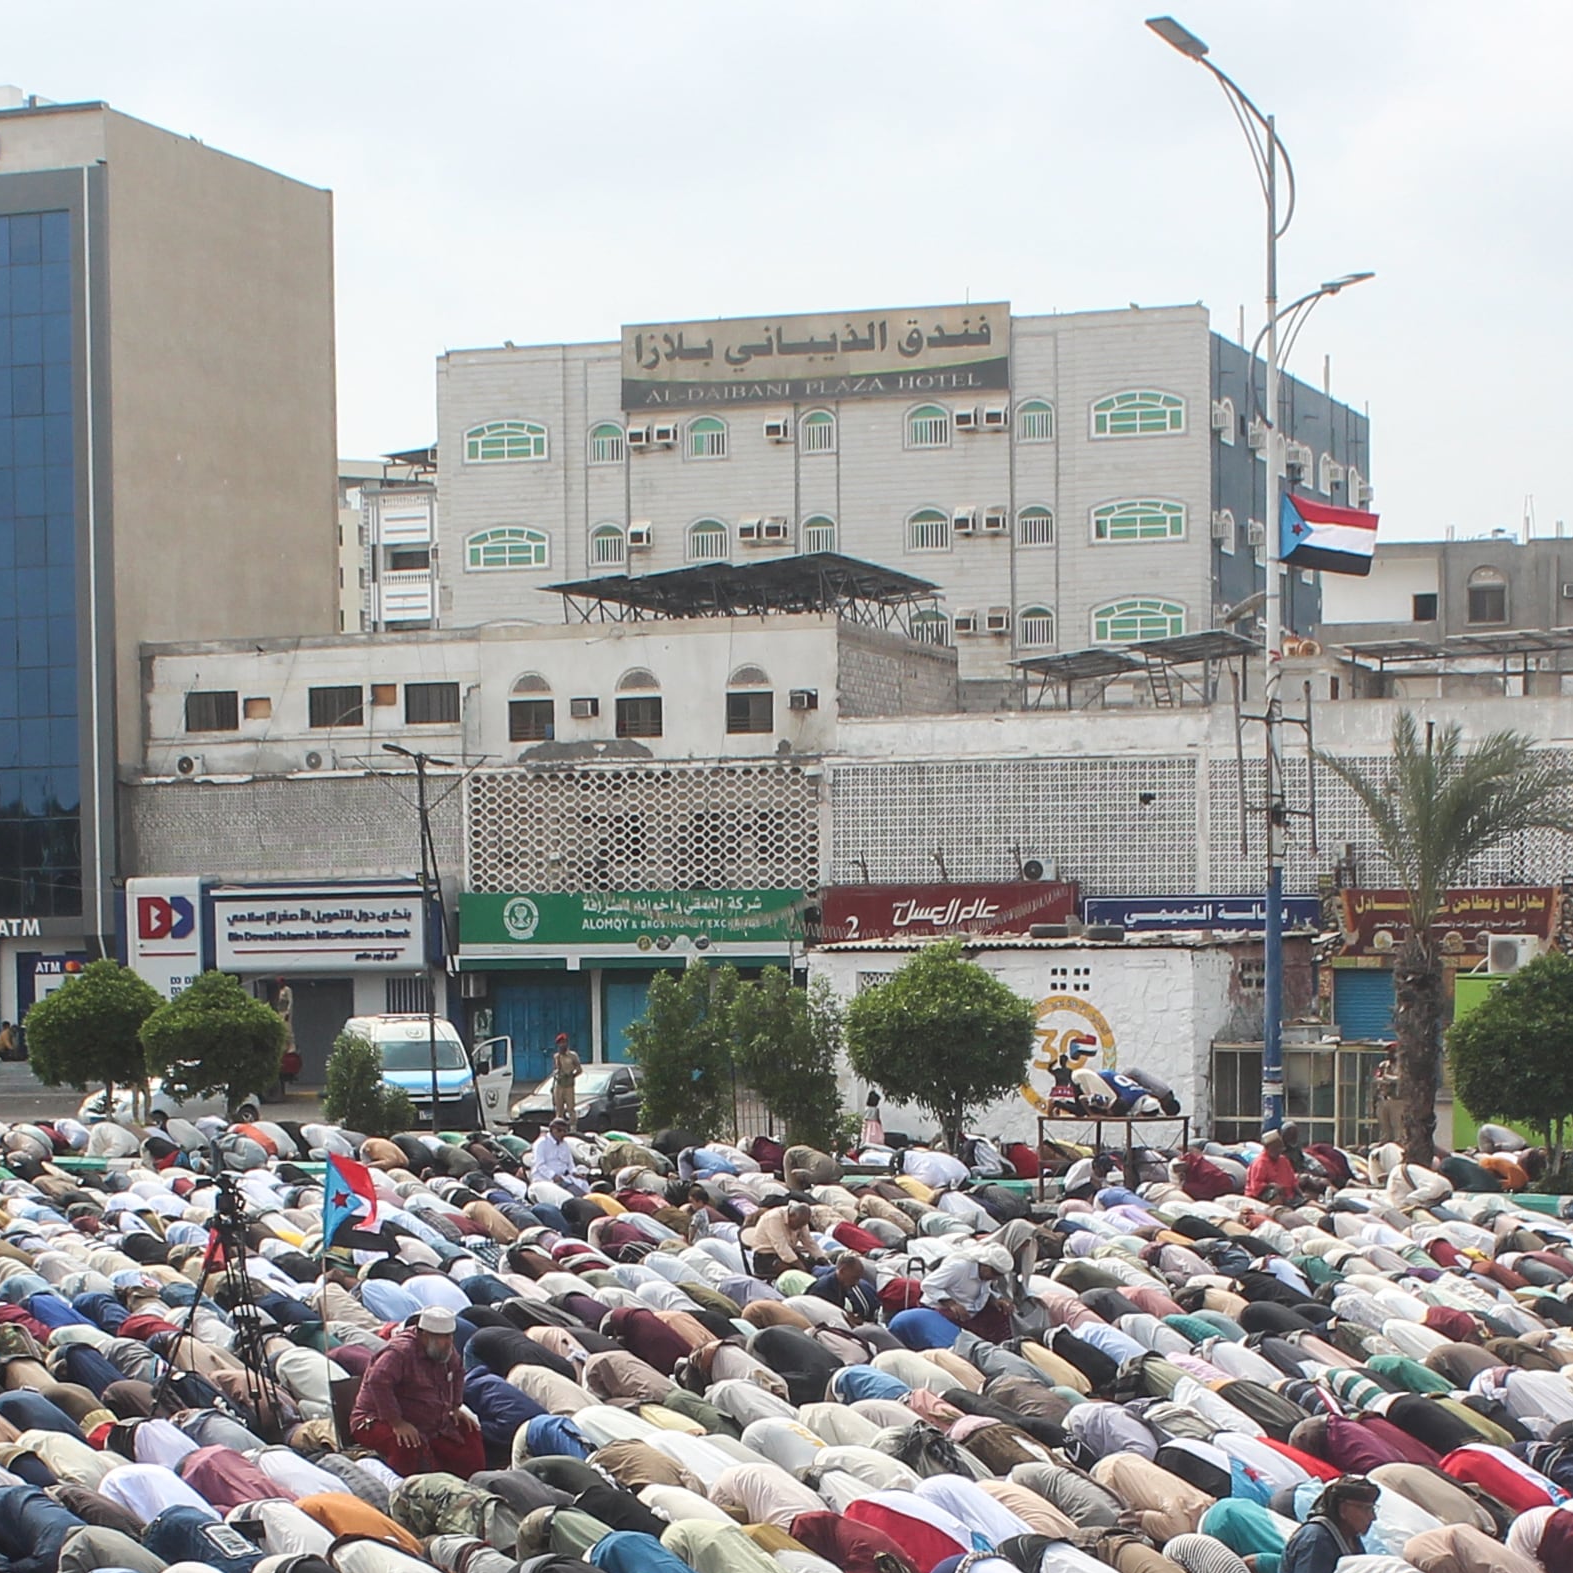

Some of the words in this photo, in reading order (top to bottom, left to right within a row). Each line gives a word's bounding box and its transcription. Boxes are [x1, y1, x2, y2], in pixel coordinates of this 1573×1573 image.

[724, 320, 887, 373] الذيباني
[897, 314, 992, 358] فندق
[634, 331, 714, 370] بلازا
[645, 382, 791, 405] AL-DAIBANI
[805, 376, 885, 396] PLAZA
[898, 371, 983, 390] HOTEL
[727, 896, 763, 913] شركة
[1124, 903, 1213, 928] التميمي
[1218, 902, 1288, 924] بالة
[1504, 893, 1545, 913] بهارات
[582, 918, 629, 932] ALOMQY
[845, 915, 860, 940] 2
[35, 961, 61, 973] ATM
